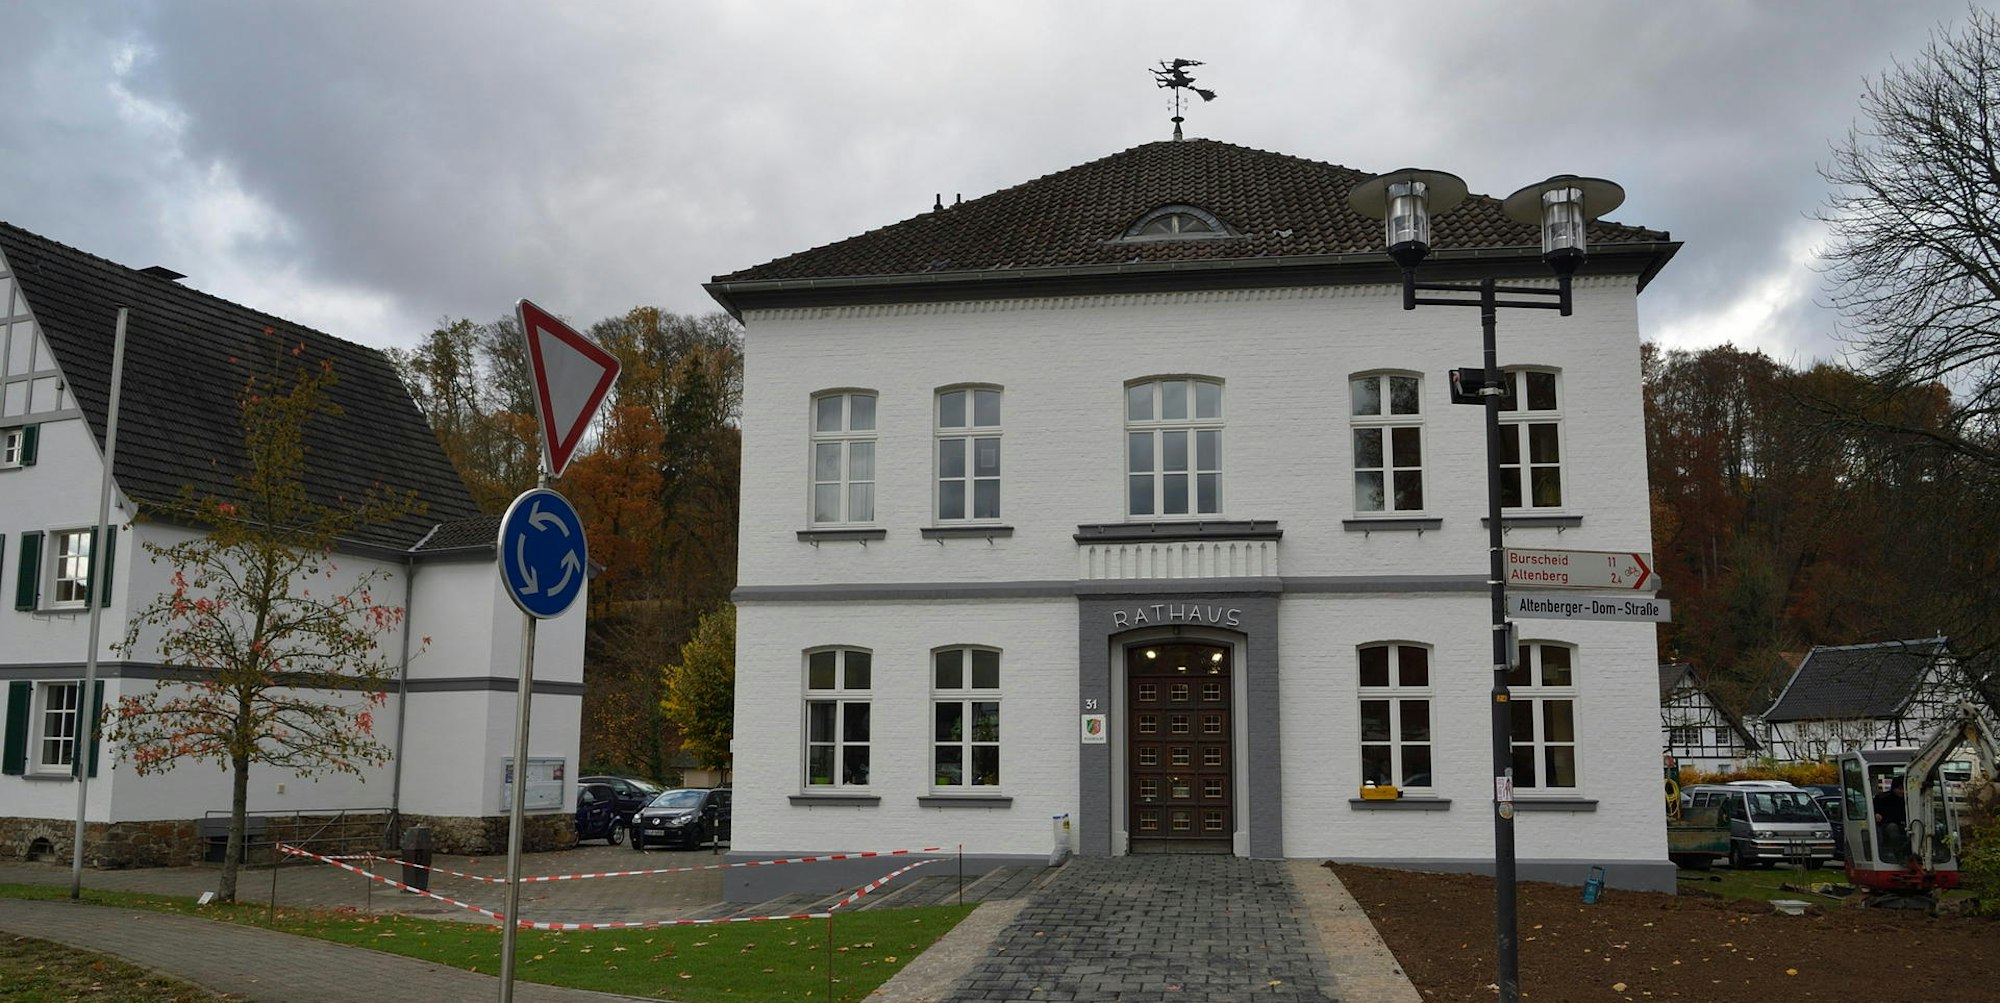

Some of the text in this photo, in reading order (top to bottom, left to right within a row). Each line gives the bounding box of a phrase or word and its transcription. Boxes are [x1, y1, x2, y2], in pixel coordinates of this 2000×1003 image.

[1510, 553, 1616, 567] Burscheid 11
[1511, 569, 1568, 584] Altenberg
[1112, 604, 1242, 627] RATHAUS
[1085, 698, 1097, 709] 31
